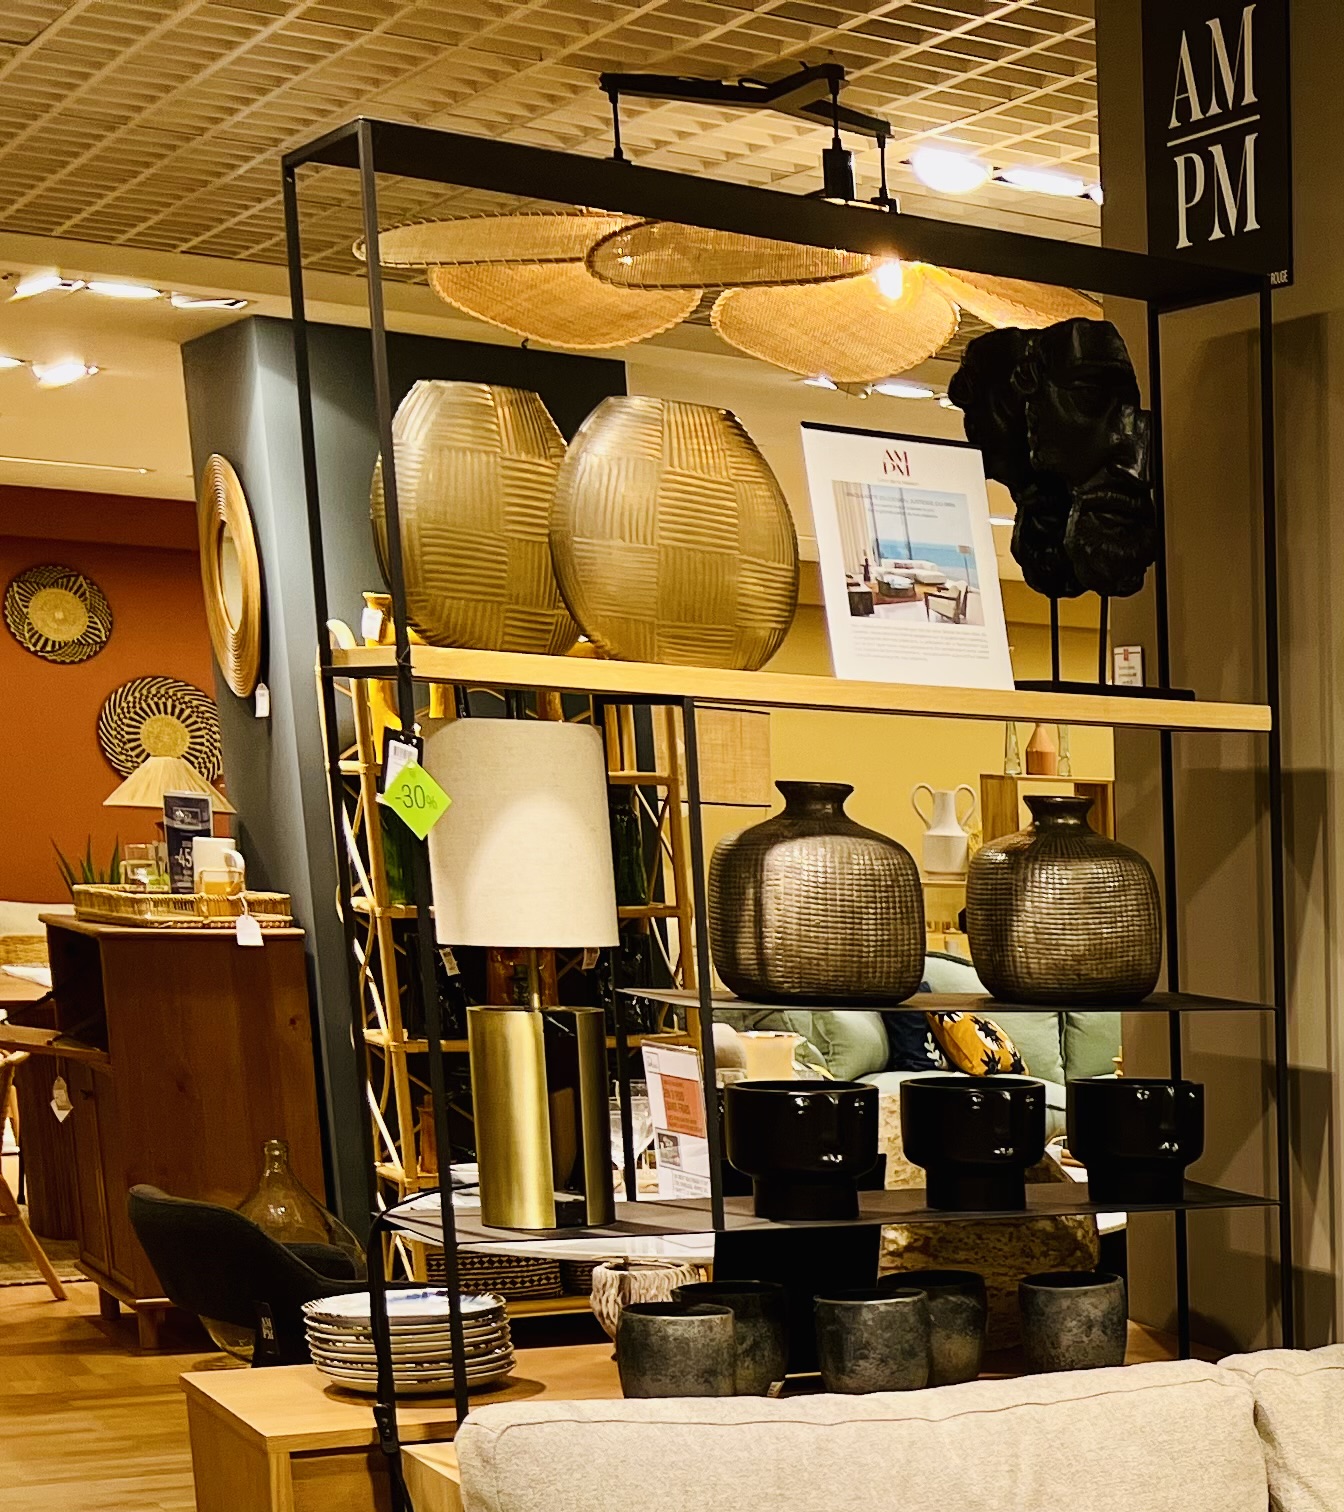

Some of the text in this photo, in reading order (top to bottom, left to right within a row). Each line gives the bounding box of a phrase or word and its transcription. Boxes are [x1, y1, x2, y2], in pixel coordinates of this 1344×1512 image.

[1168, 3, 1259, 130] AM
[1173, 132, 1261, 250] PM
[394, 783, 438, 810] -30%
